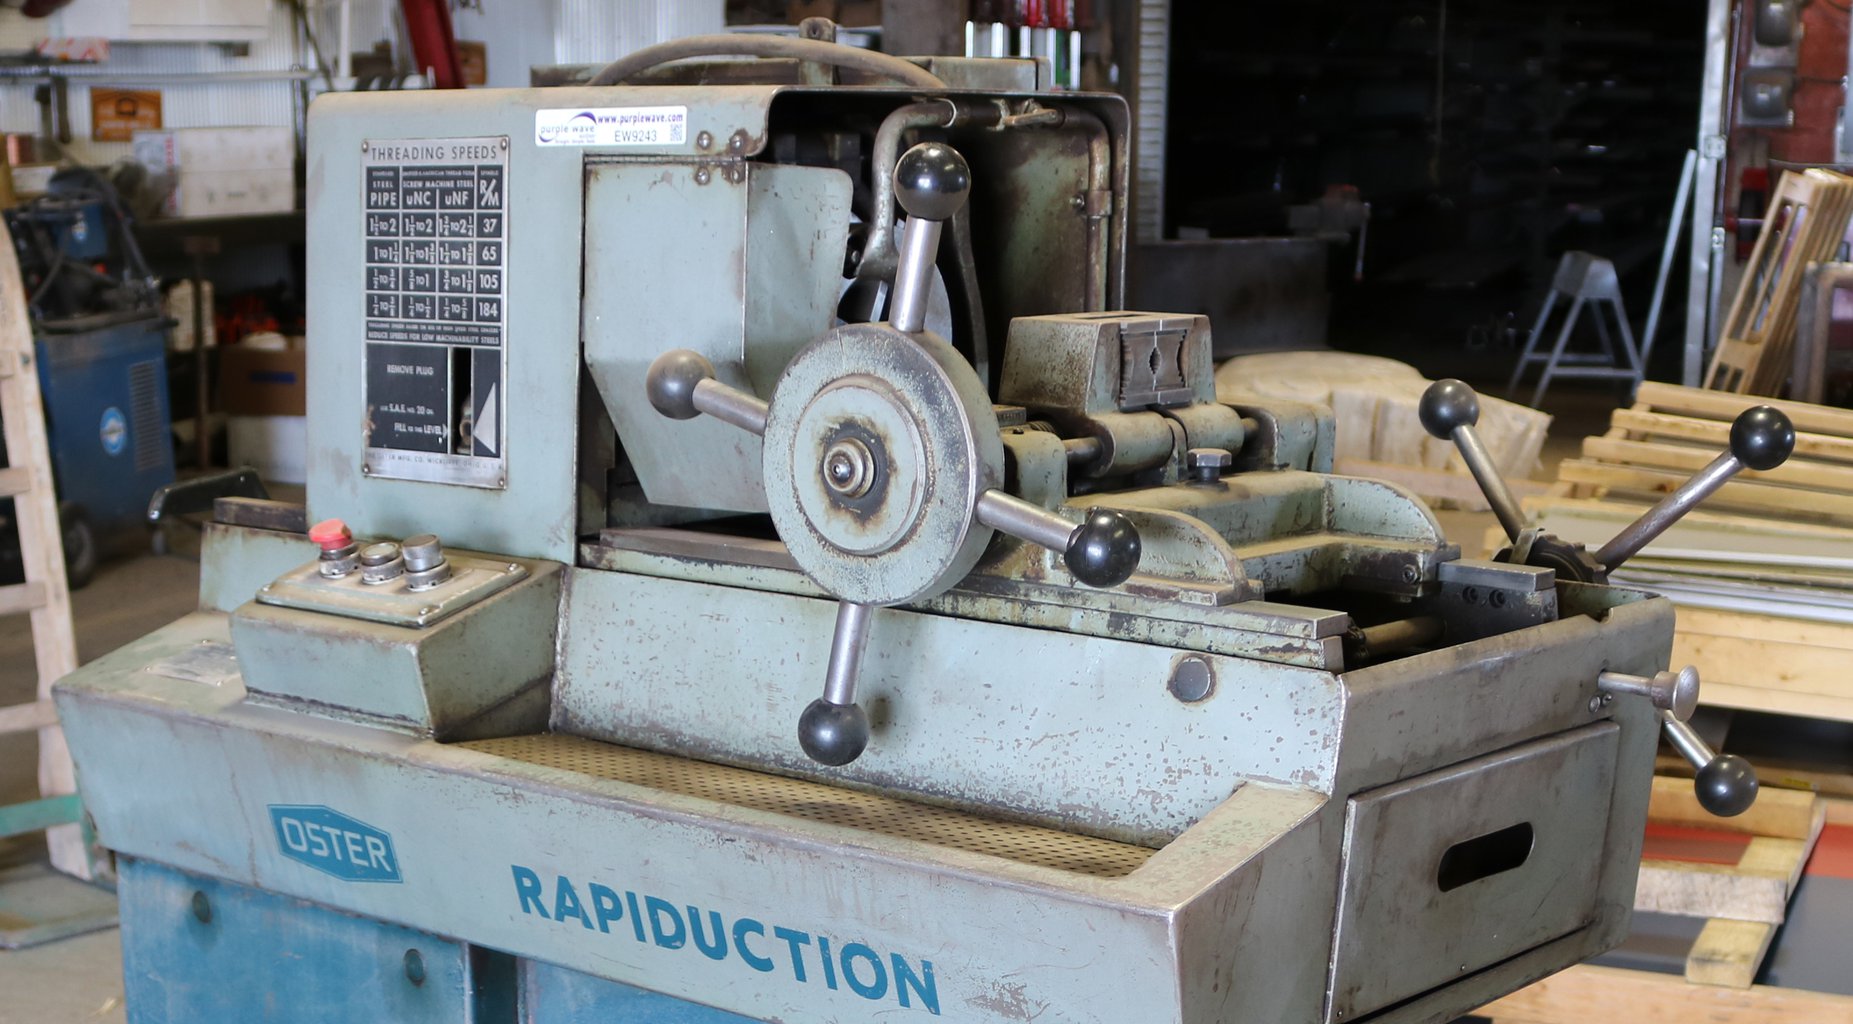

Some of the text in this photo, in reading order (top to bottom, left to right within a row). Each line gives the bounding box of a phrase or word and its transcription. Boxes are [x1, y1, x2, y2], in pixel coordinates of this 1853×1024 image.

[597, 112, 684, 126] www.purplewave.com
[540, 122, 569, 136] purple
[571, 124, 596, 133] wave
[614, 129, 658, 143] EW9243
[371, 145, 498, 161] THREADING SPEEDS
[456, 180, 474, 188] STEEL
[370, 192, 397, 206] PIPE
[483, 218, 497, 233] 37
[482, 246, 497, 261] 65
[479, 274, 499, 289] 105
[478, 302, 499, 317] 184
[389, 332, 408, 340] SPEEDS
[409, 332, 421, 341] FOR
[421, 333, 435, 341] LOW
[480, 336, 500, 345] STEELS
[386, 364, 435, 376] REMOVE PLUG
[423, 424, 442, 435] LEVEL
[281, 816, 392, 873] OSTER
[511, 864, 942, 1015] RAPIDUCTION
